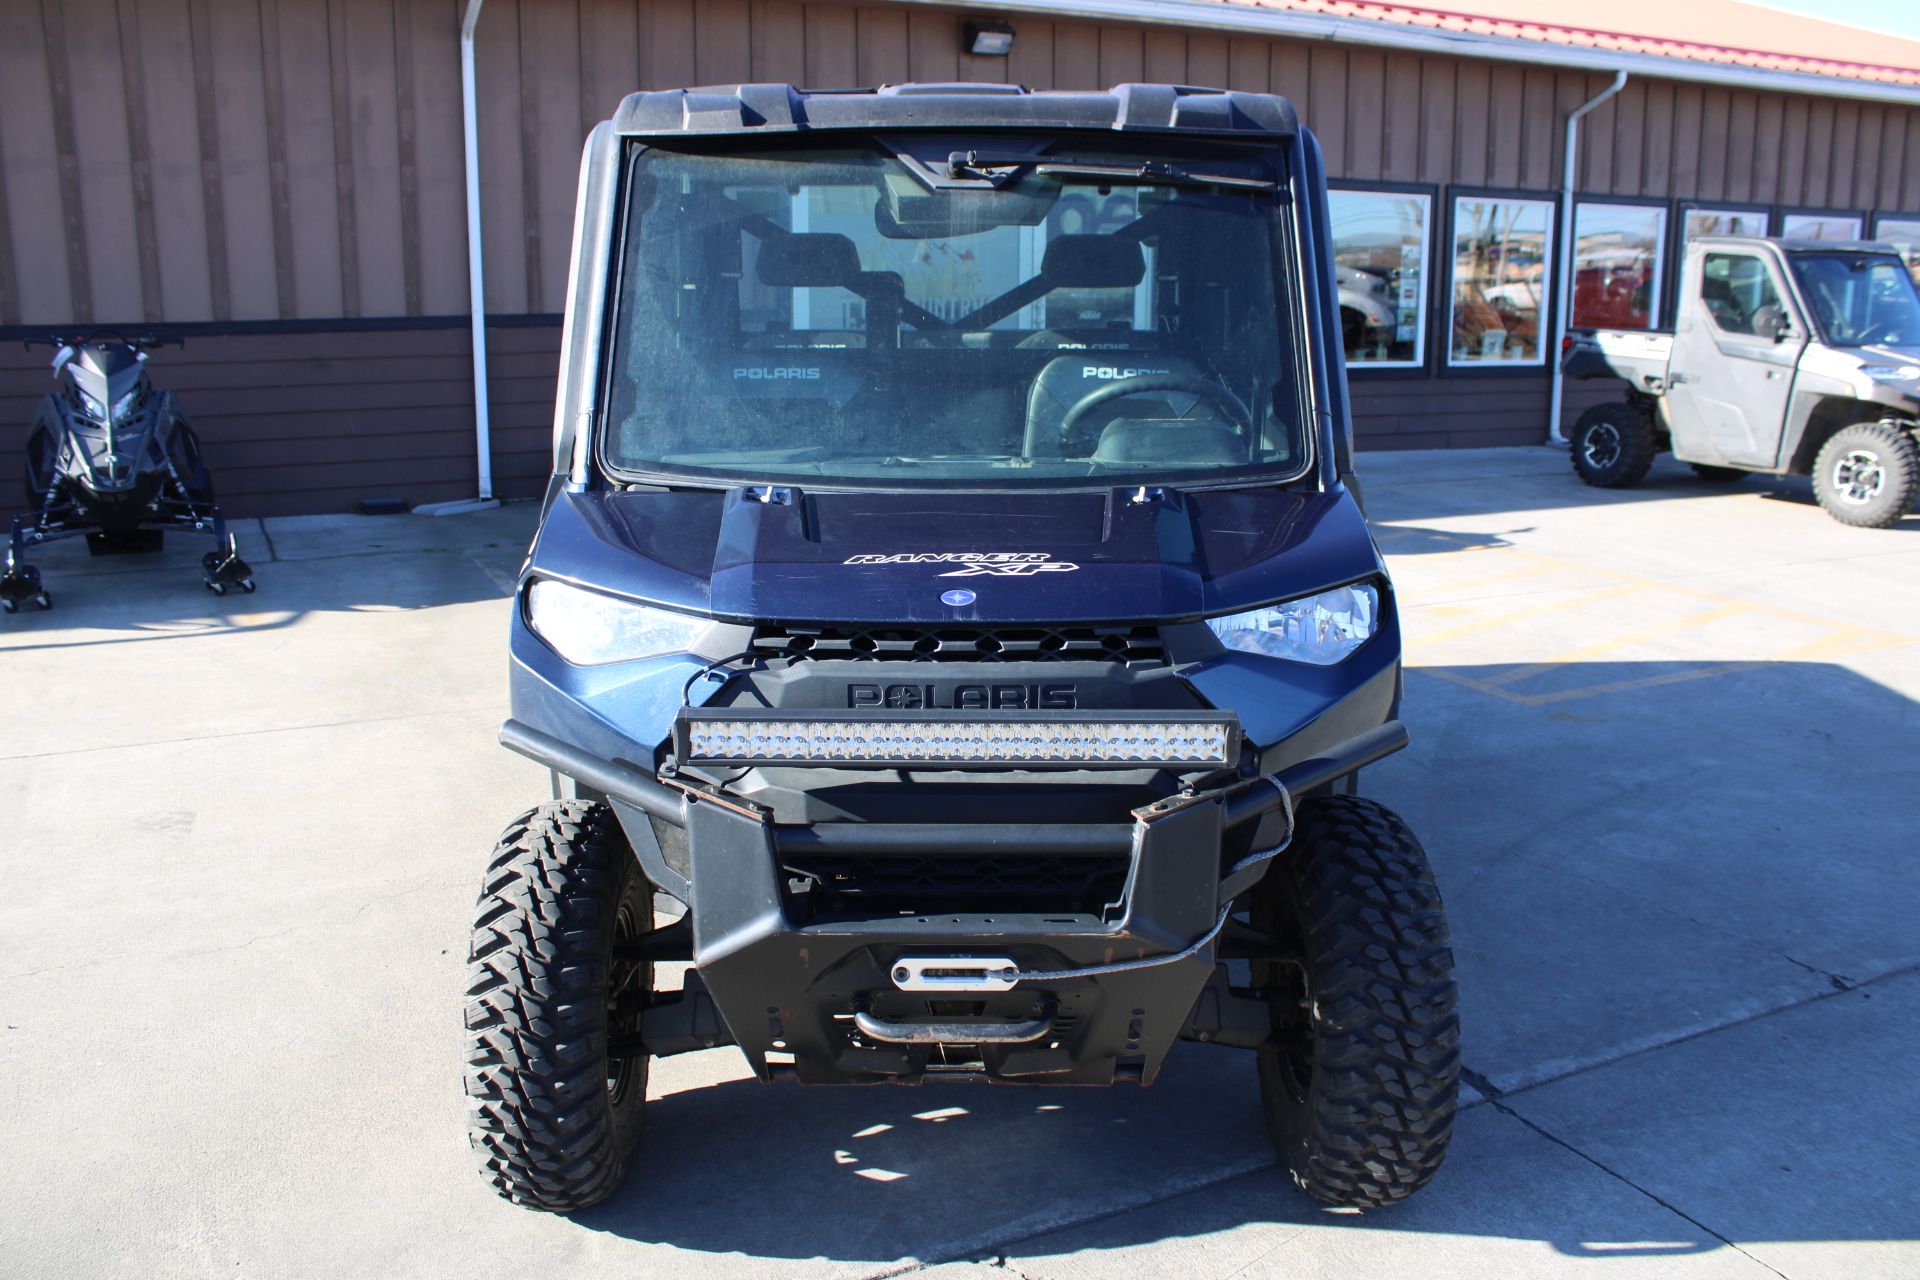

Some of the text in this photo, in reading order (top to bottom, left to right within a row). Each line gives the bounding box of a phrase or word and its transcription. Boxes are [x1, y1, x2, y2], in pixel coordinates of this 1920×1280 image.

[733, 367, 820, 379] POLARIS
[844, 553, 1051, 564] RANGER
[936, 562, 1080, 577] XP
[848, 683, 1078, 710] POLARIS
